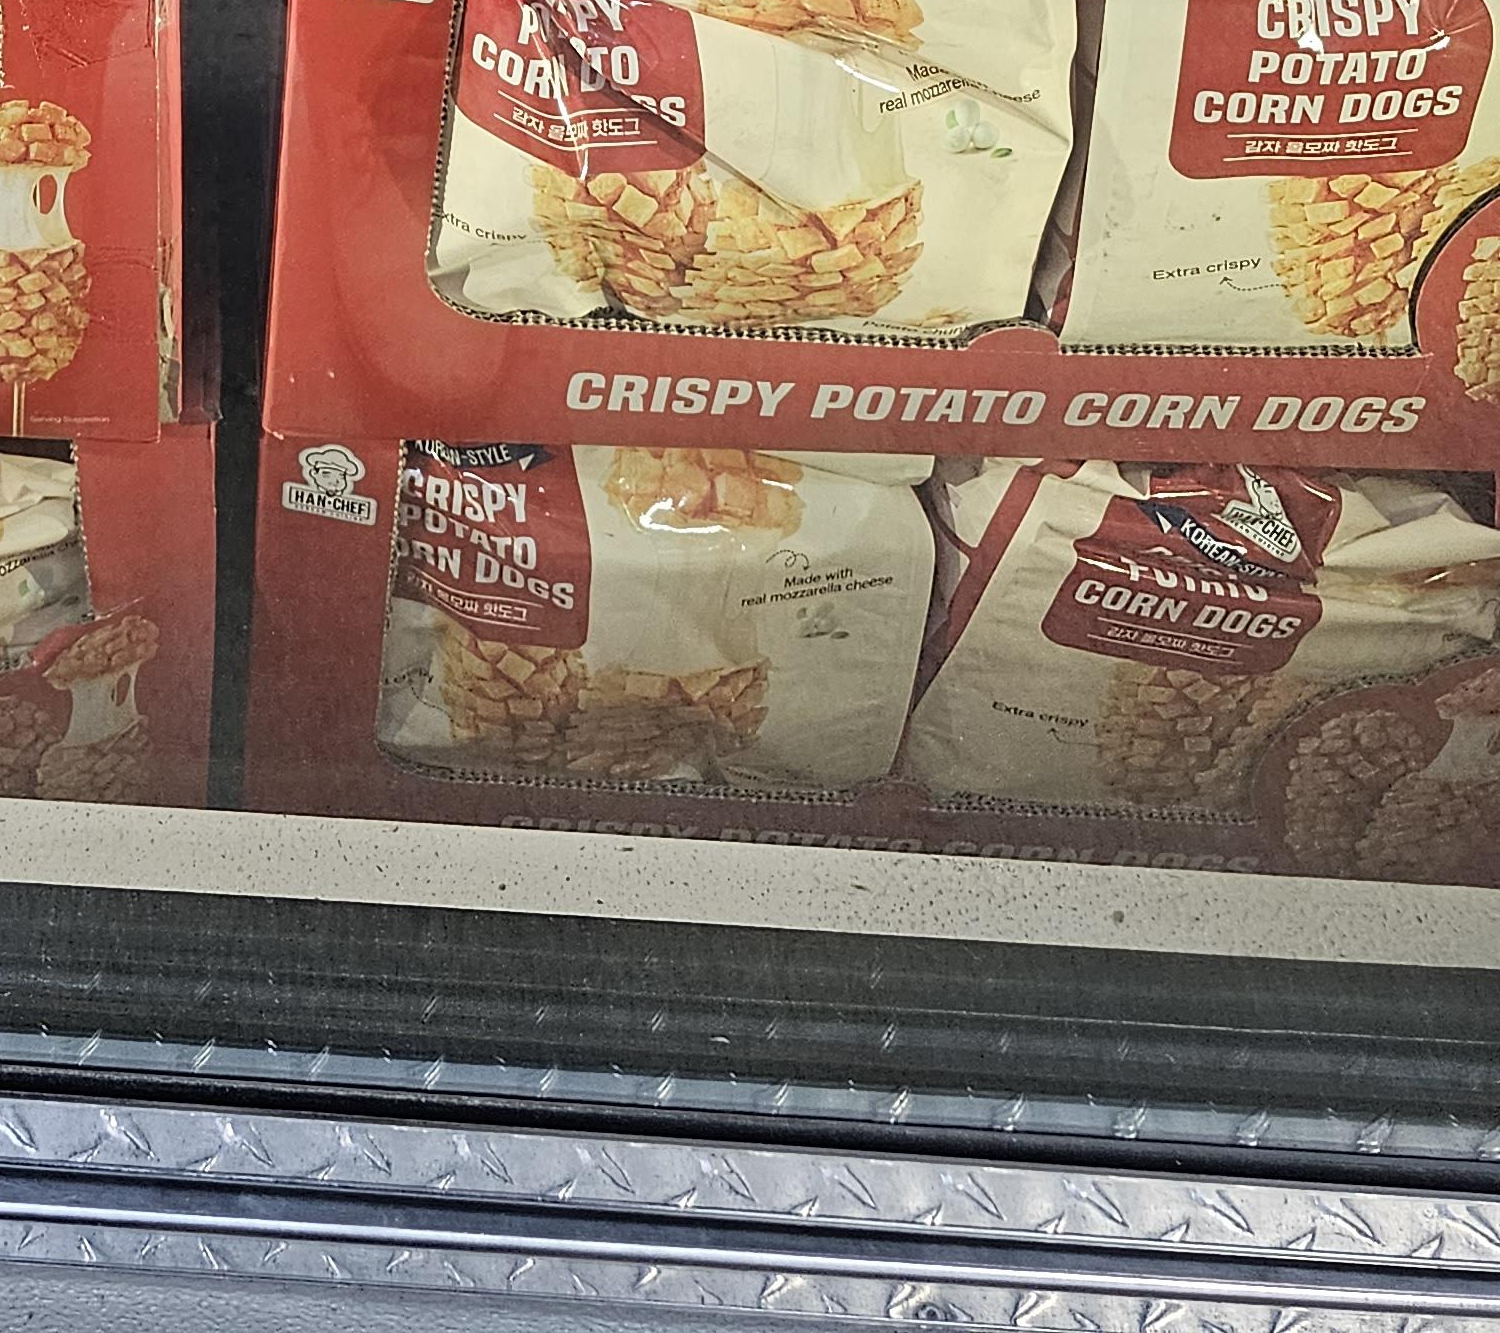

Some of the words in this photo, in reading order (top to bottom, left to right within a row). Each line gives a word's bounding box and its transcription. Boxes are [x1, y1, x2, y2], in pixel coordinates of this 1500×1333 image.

[1248, 49, 1430, 85] POTATO
[1193, 90, 1323, 126] CORN
[1338, 85, 1464, 124] DOGS
[1152, 267, 1201, 281] Extra
[1205, 257, 1262, 278] crispy
[565, 371, 797, 420] CRISPY
[809, 383, 1047, 427] POTATO
[1062, 391, 1242, 430] CORN
[1252, 395, 1428, 434] DOGS
[403, 469, 527, 523] CRISPY
[401, 502, 538, 571] POTATO
[475, 552, 575, 610] DOGS
[1073, 579, 1188, 623] CORN
[1193, 604, 1302, 639] DOGS
